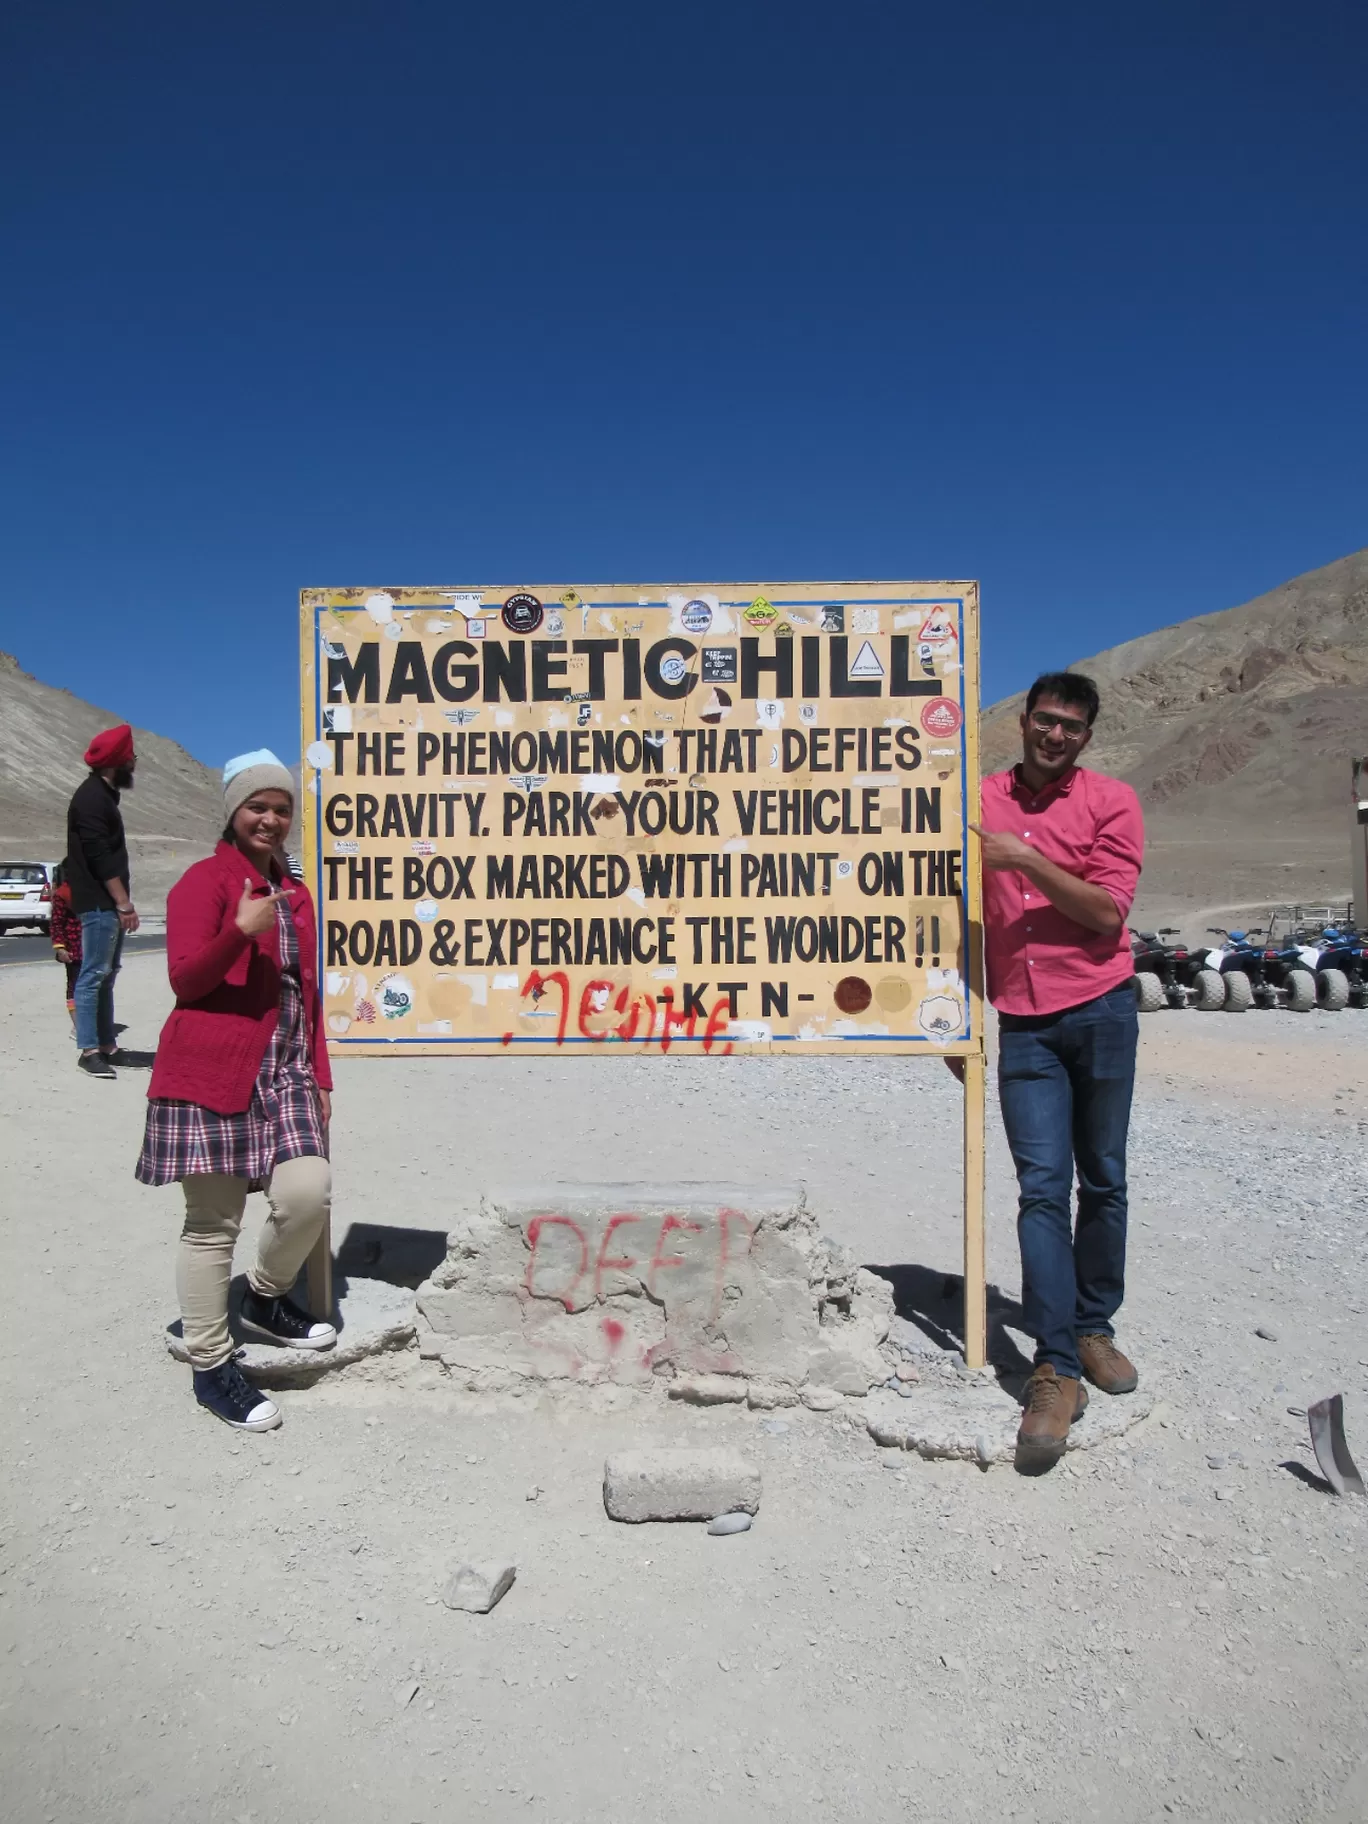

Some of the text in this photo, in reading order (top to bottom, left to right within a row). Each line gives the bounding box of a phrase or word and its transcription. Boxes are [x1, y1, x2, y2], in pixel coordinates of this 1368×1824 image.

[327, 636, 943, 704] MAGNETIC HILL
[326, 726, 922, 775] THE PHENOMENON THAT DEFIES
[325, 788, 942, 838] GRAVITY. PARK YOUR VEHICLE IN
[323, 850, 963, 901] THE BOX MARKED WITH PAINT ON THE
[327, 919, 422, 967] ROAD
[464, 916, 677, 967] EXPERIANCE
[685, 916, 757, 965] THE
